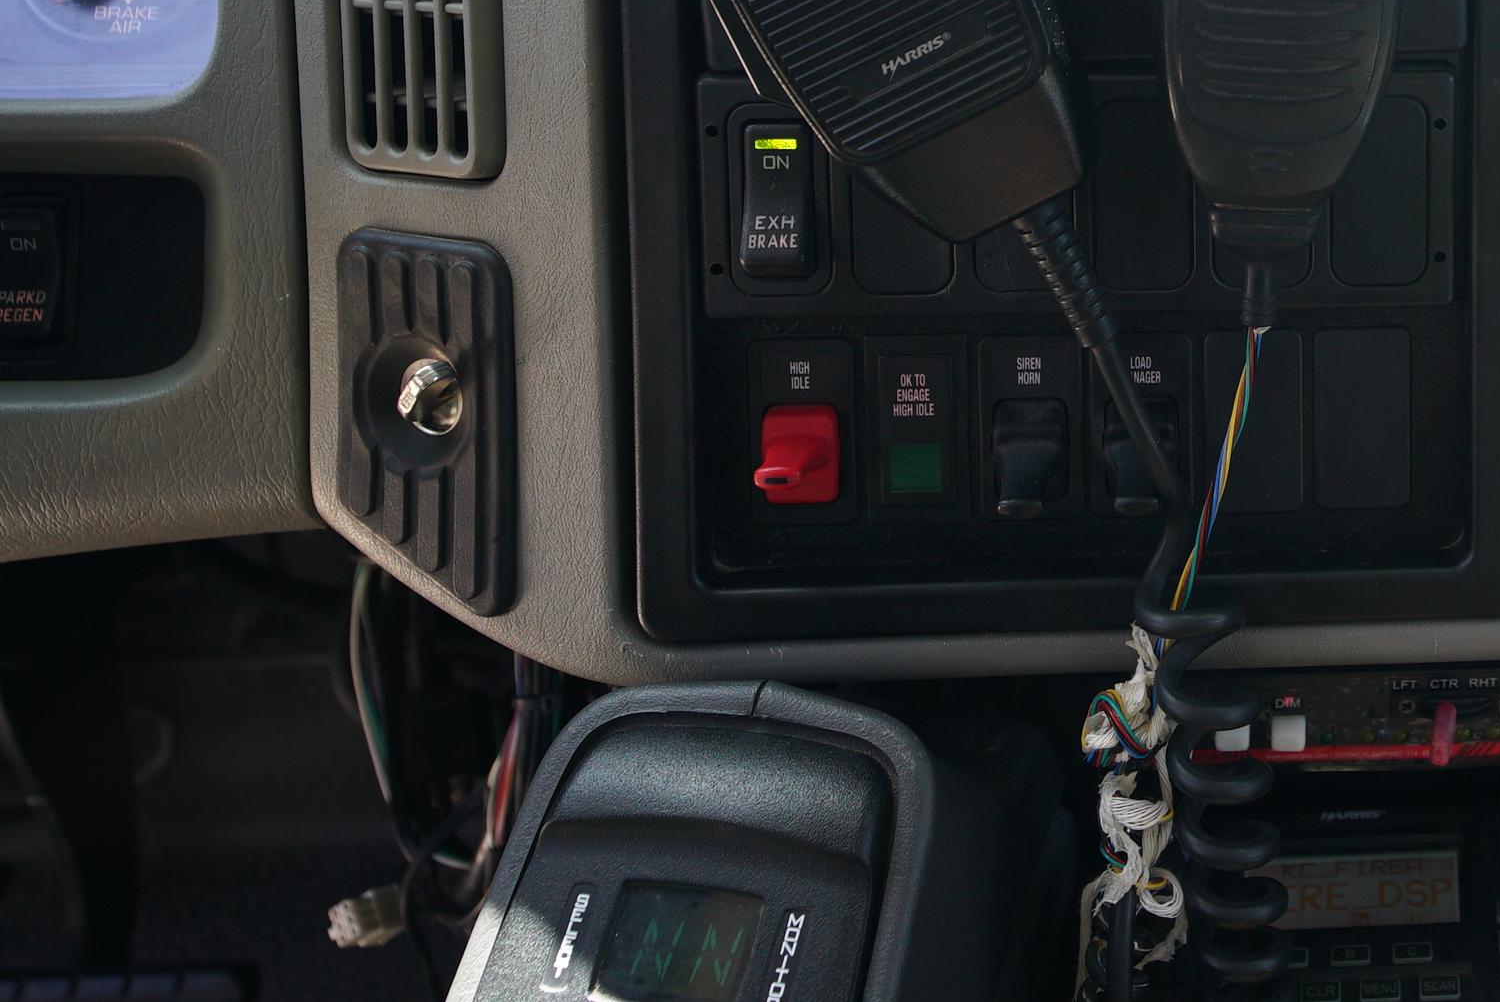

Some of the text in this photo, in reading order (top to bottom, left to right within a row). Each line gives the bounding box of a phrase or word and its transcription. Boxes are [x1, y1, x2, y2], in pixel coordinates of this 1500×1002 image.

[94, 5, 159, 21] BRAKE
[109, 20, 142, 34] AIR
[762, 155, 790, 170] ON
[754, 215, 795, 230] EXH
[9, 237, 37, 251] ON
[748, 233, 798, 249] BRAKE
[0, 308, 43, 322] EGEN
[789, 361, 810, 375] HIGH
[1016, 357, 1041, 370] SIREN
[1130, 356, 1152, 369] LOAD
[790, 376, 810, 390] IDLE
[900, 373, 926, 387] OK TO
[1017, 371, 1041, 385] HORN
[1131, 371, 1161, 384] NAGER
[896, 388, 930, 402] ENGAGE
[893, 403, 935, 417] HIGH IDLE
[1392, 679, 1418, 691] LFT
[1430, 678, 1458, 689] CTR
[1468, 677, 1498, 688] RHT
[1274, 698, 1301, 709] DIM
[1287, 876, 1453, 913] RE_DSP
[766, 912, 805, 1002] MONITO
[1406, 946, 1417, 956] C
[1305, 985, 1336, 997] CLR
[1362, 982, 1397, 995] MENU
[1422, 979, 1456, 992] SCAN
